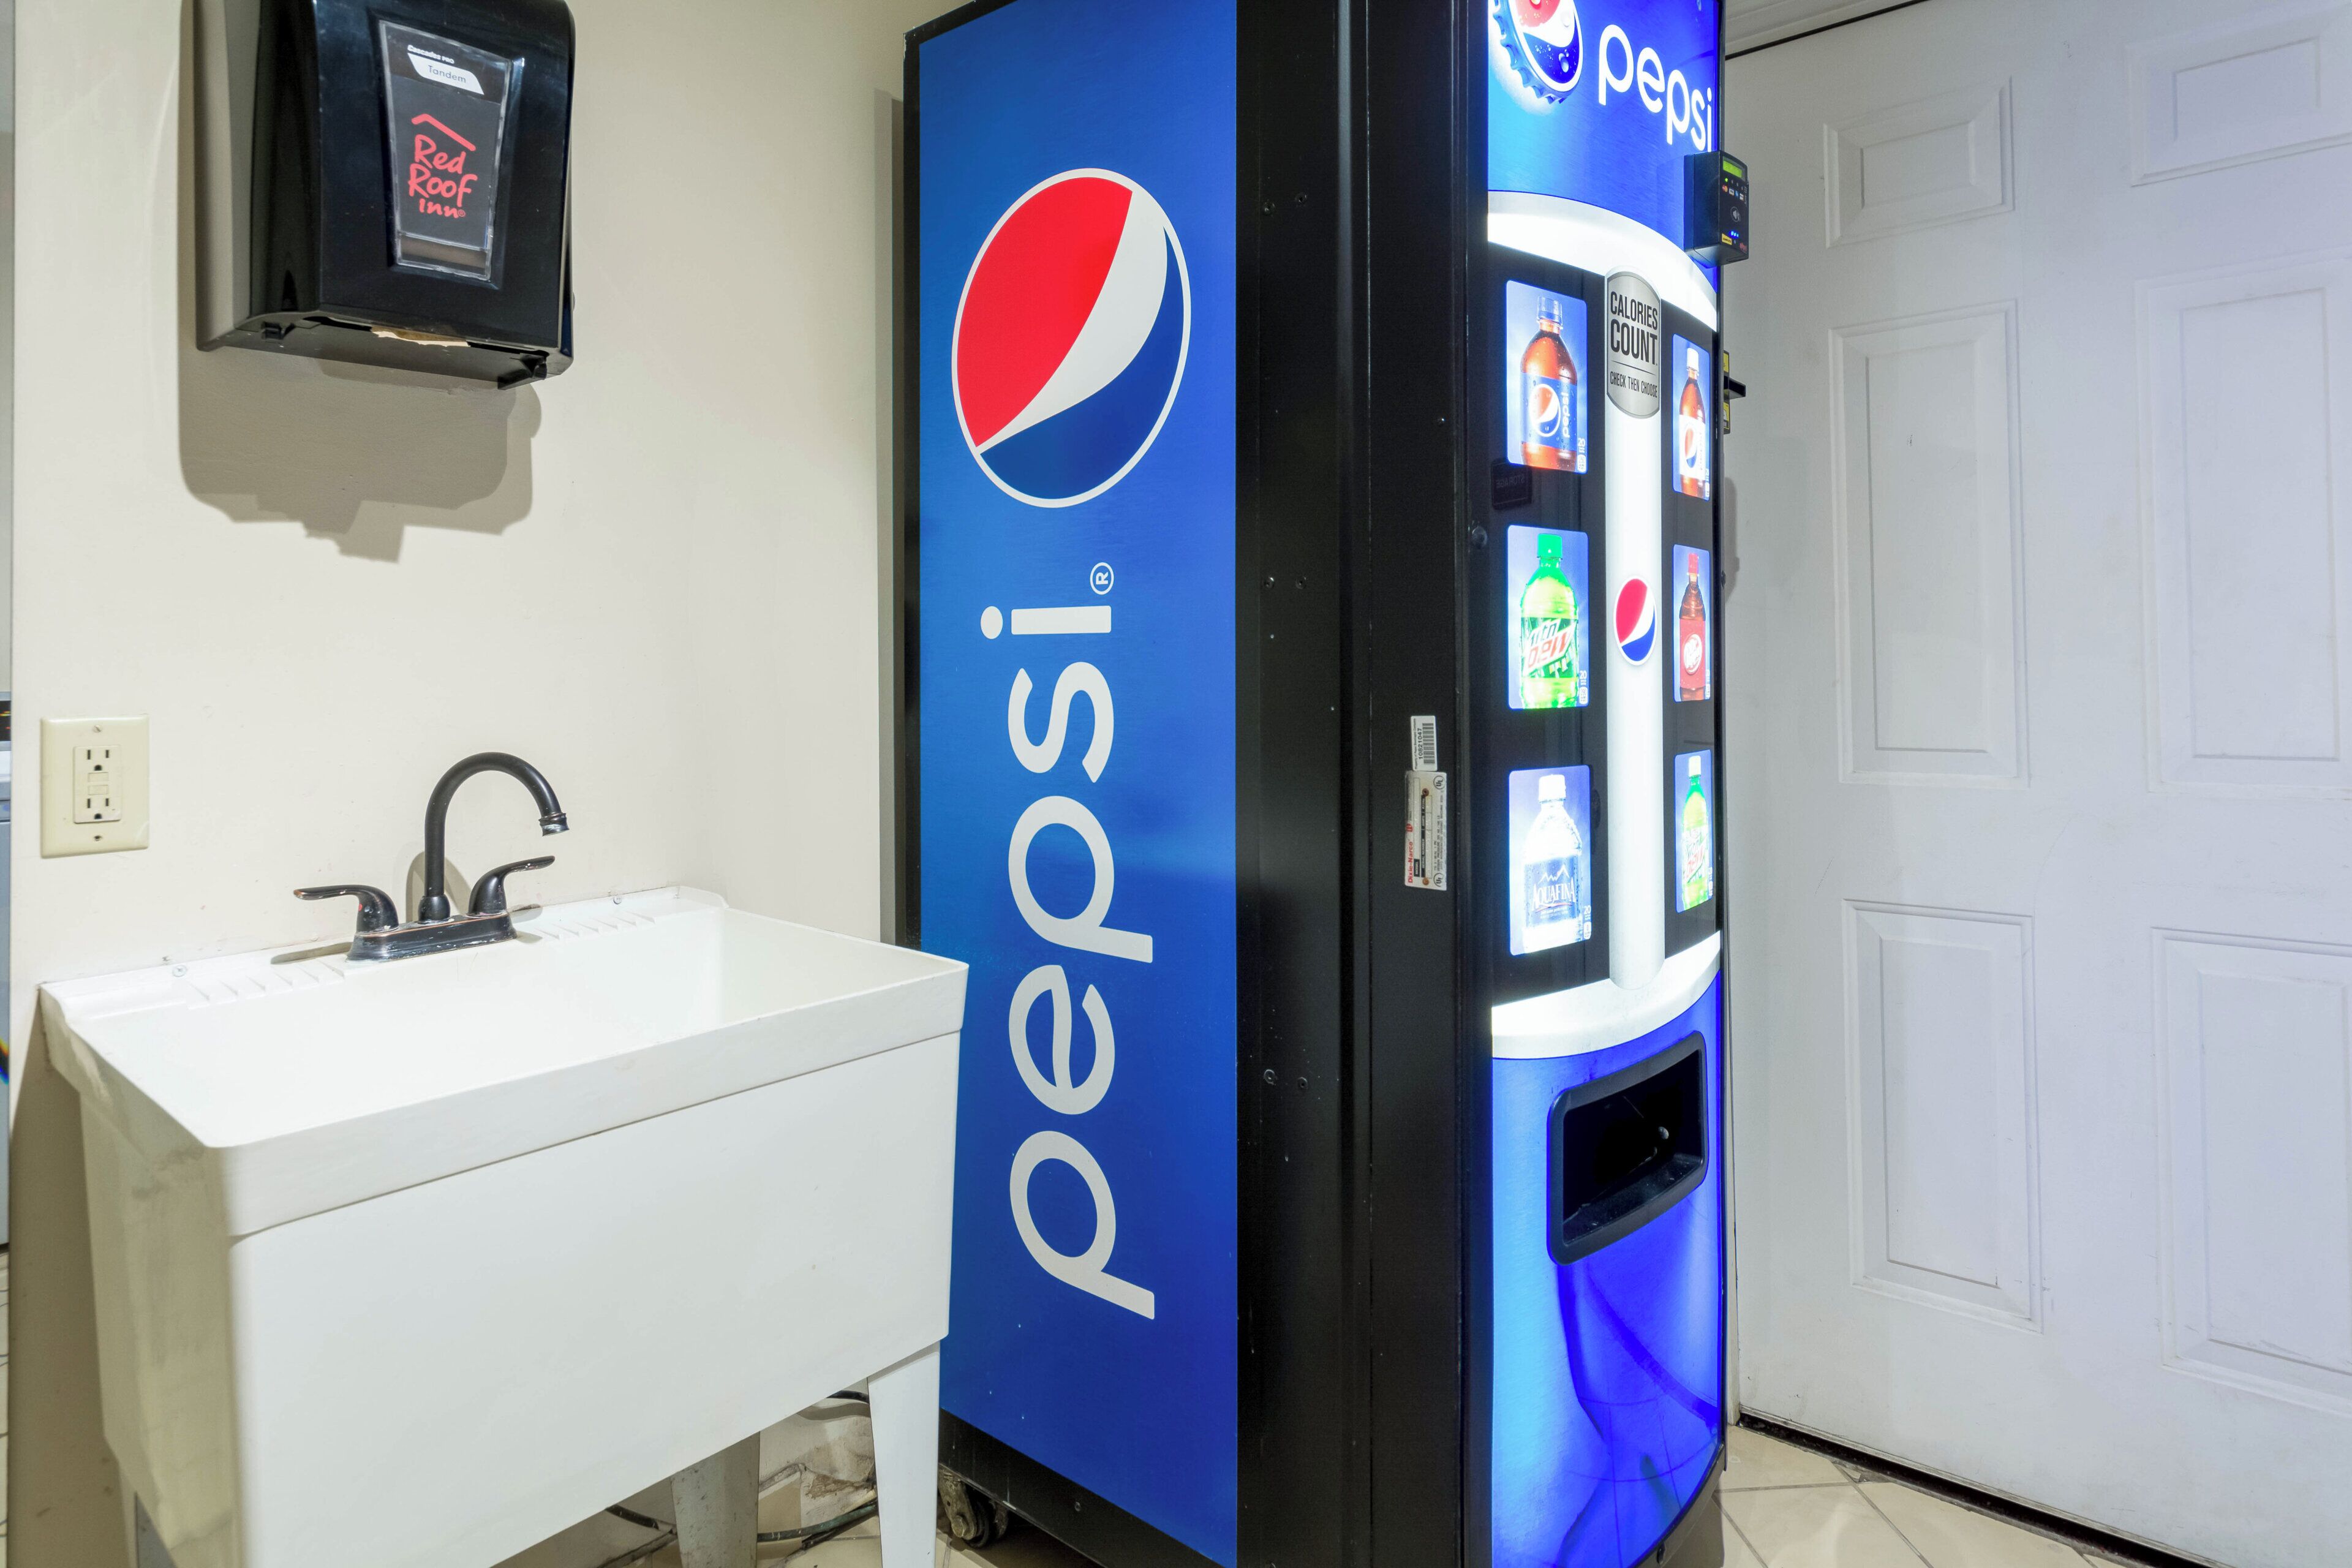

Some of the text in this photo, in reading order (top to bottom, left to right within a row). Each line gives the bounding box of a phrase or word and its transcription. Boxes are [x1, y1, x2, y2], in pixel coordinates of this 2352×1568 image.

[428, 64, 466, 83] Tandem
[1599, 24, 1712, 152] pepsi
[414, 134, 466, 174] Red
[408, 164, 478, 207] Roof
[1610, 291, 1658, 331] CALORIES
[1610, 371, 1658, 398] CHECK THEN CHOOSE
[1561, 392, 1570, 439] pepsi
[1531, 877, 1576, 911] AQUAFINA
